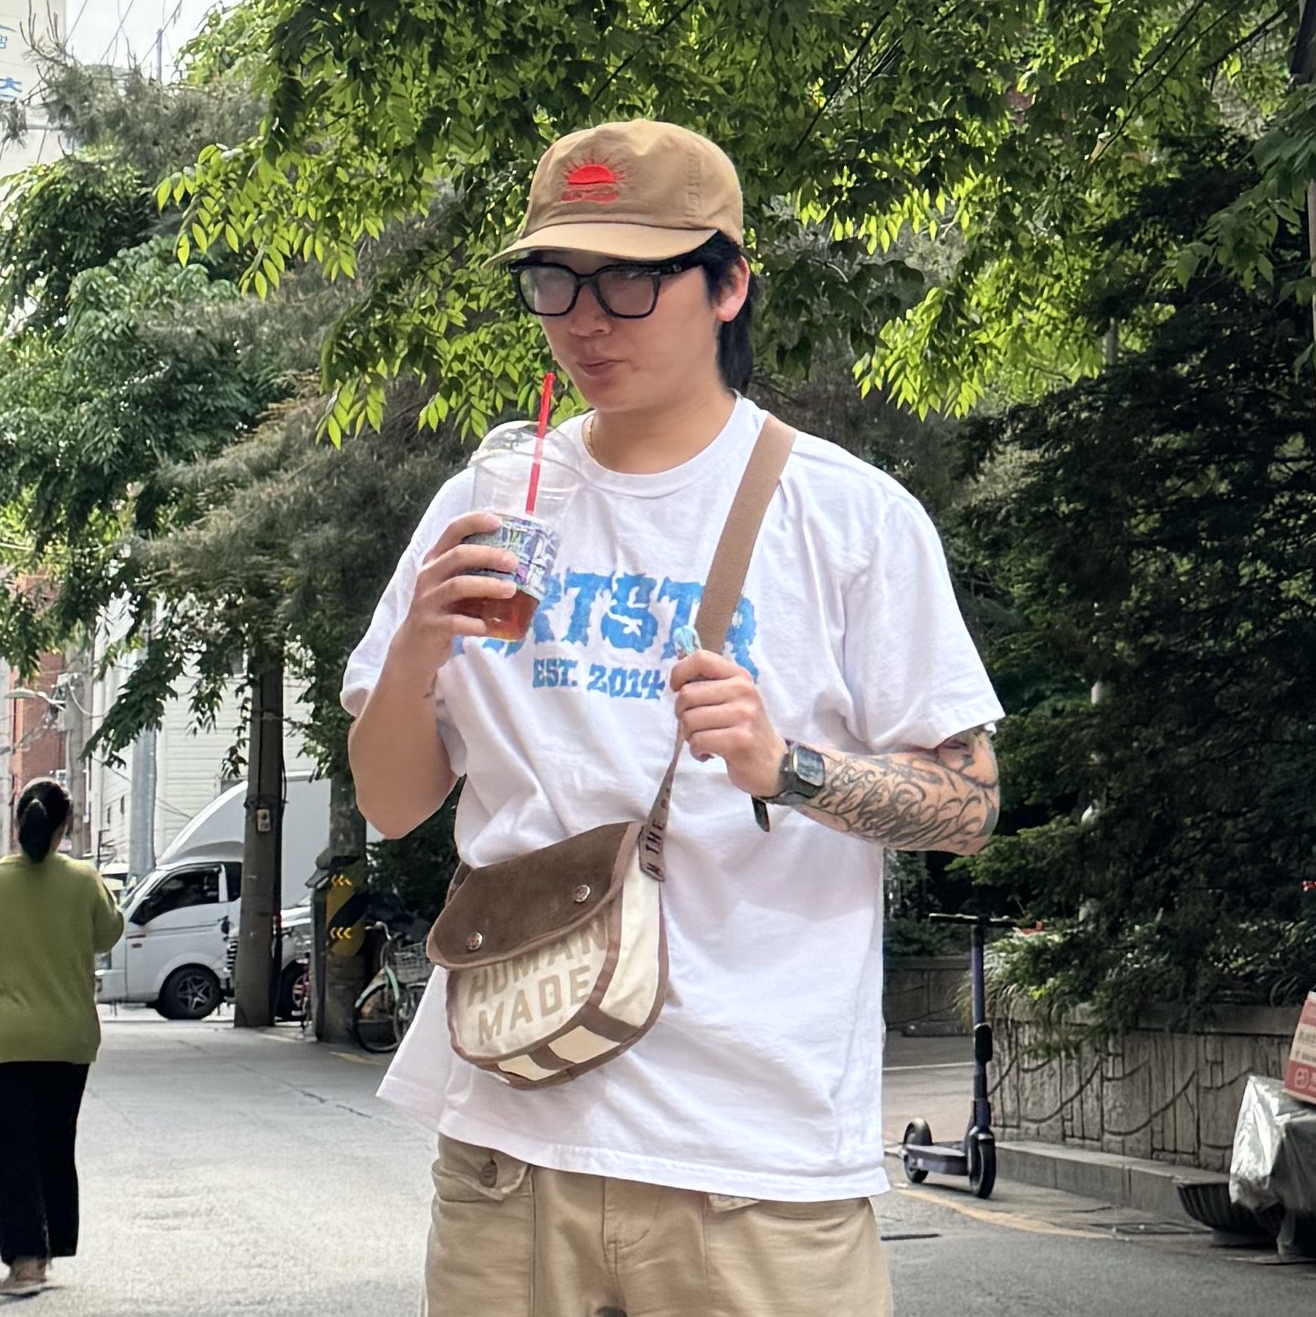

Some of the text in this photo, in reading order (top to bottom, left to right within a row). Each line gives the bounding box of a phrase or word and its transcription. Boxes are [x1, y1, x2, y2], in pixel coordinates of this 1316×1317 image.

[532, 658, 666, 701] EST. 2014
[478, 964, 591, 1045] MADE
